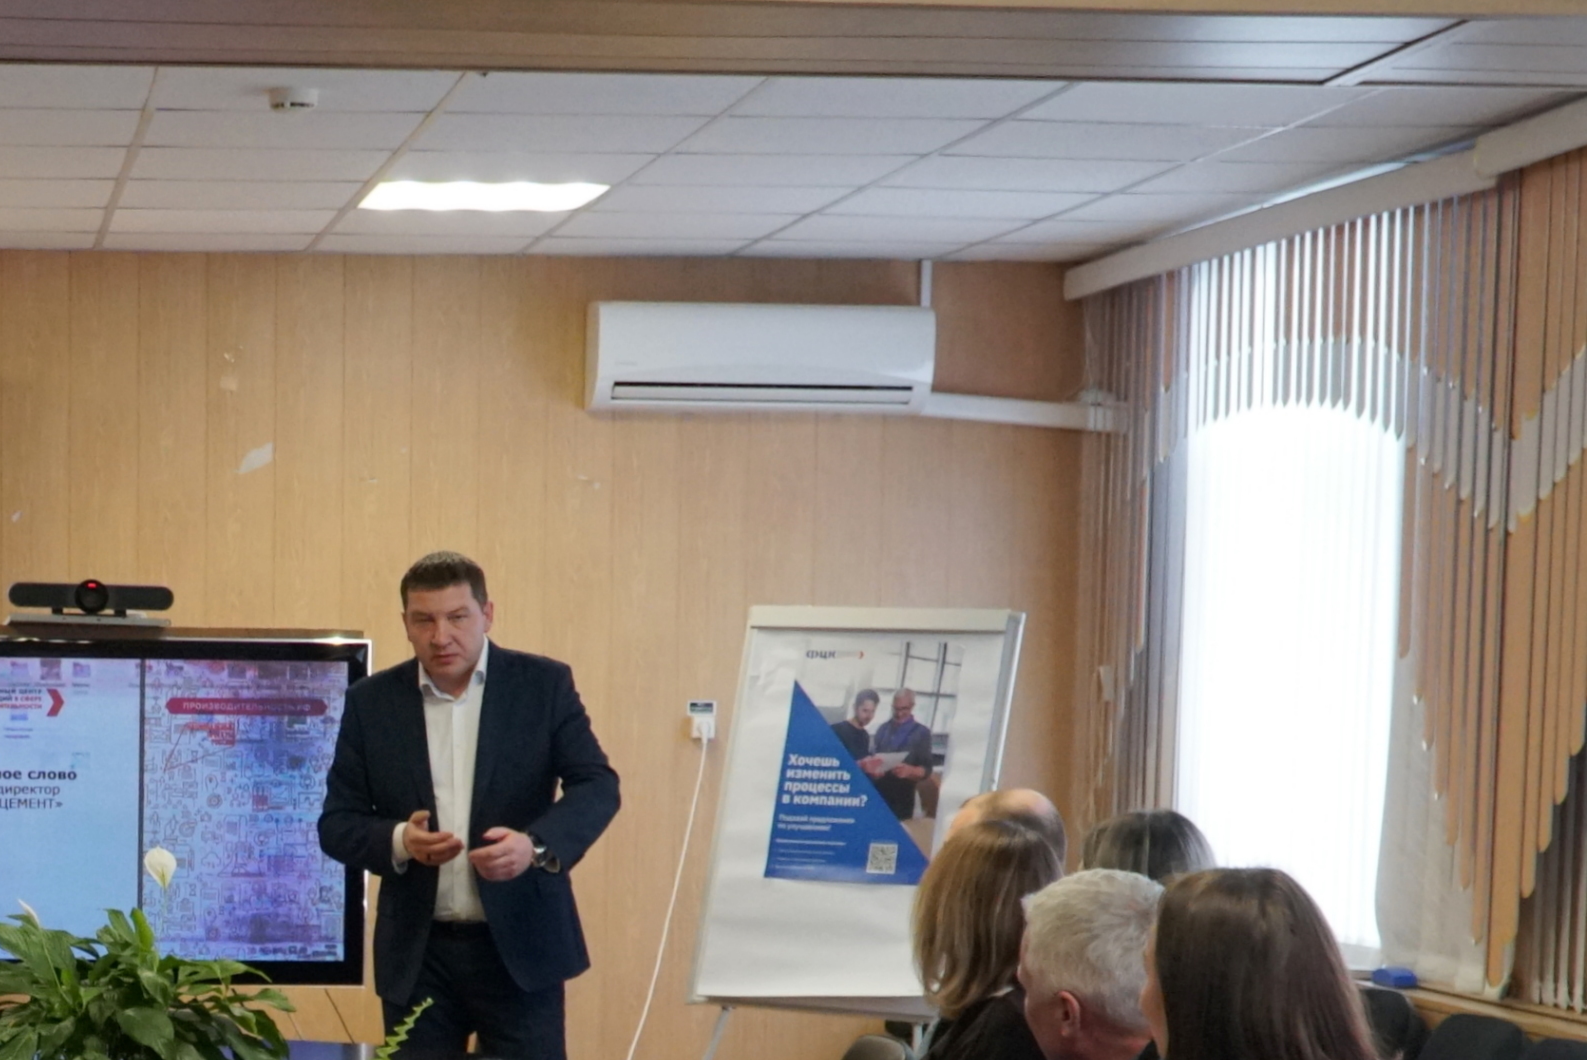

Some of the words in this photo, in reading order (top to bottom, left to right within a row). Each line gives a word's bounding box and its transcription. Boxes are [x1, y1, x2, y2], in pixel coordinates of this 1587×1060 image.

[788, 754, 840, 768] Хочешь
[27, 768, 77, 781] слово
[786, 769, 851, 781] изменить
[784, 781, 850, 796] процессы
[782, 795, 790, 804] в
[793, 795, 868, 807] компании?
